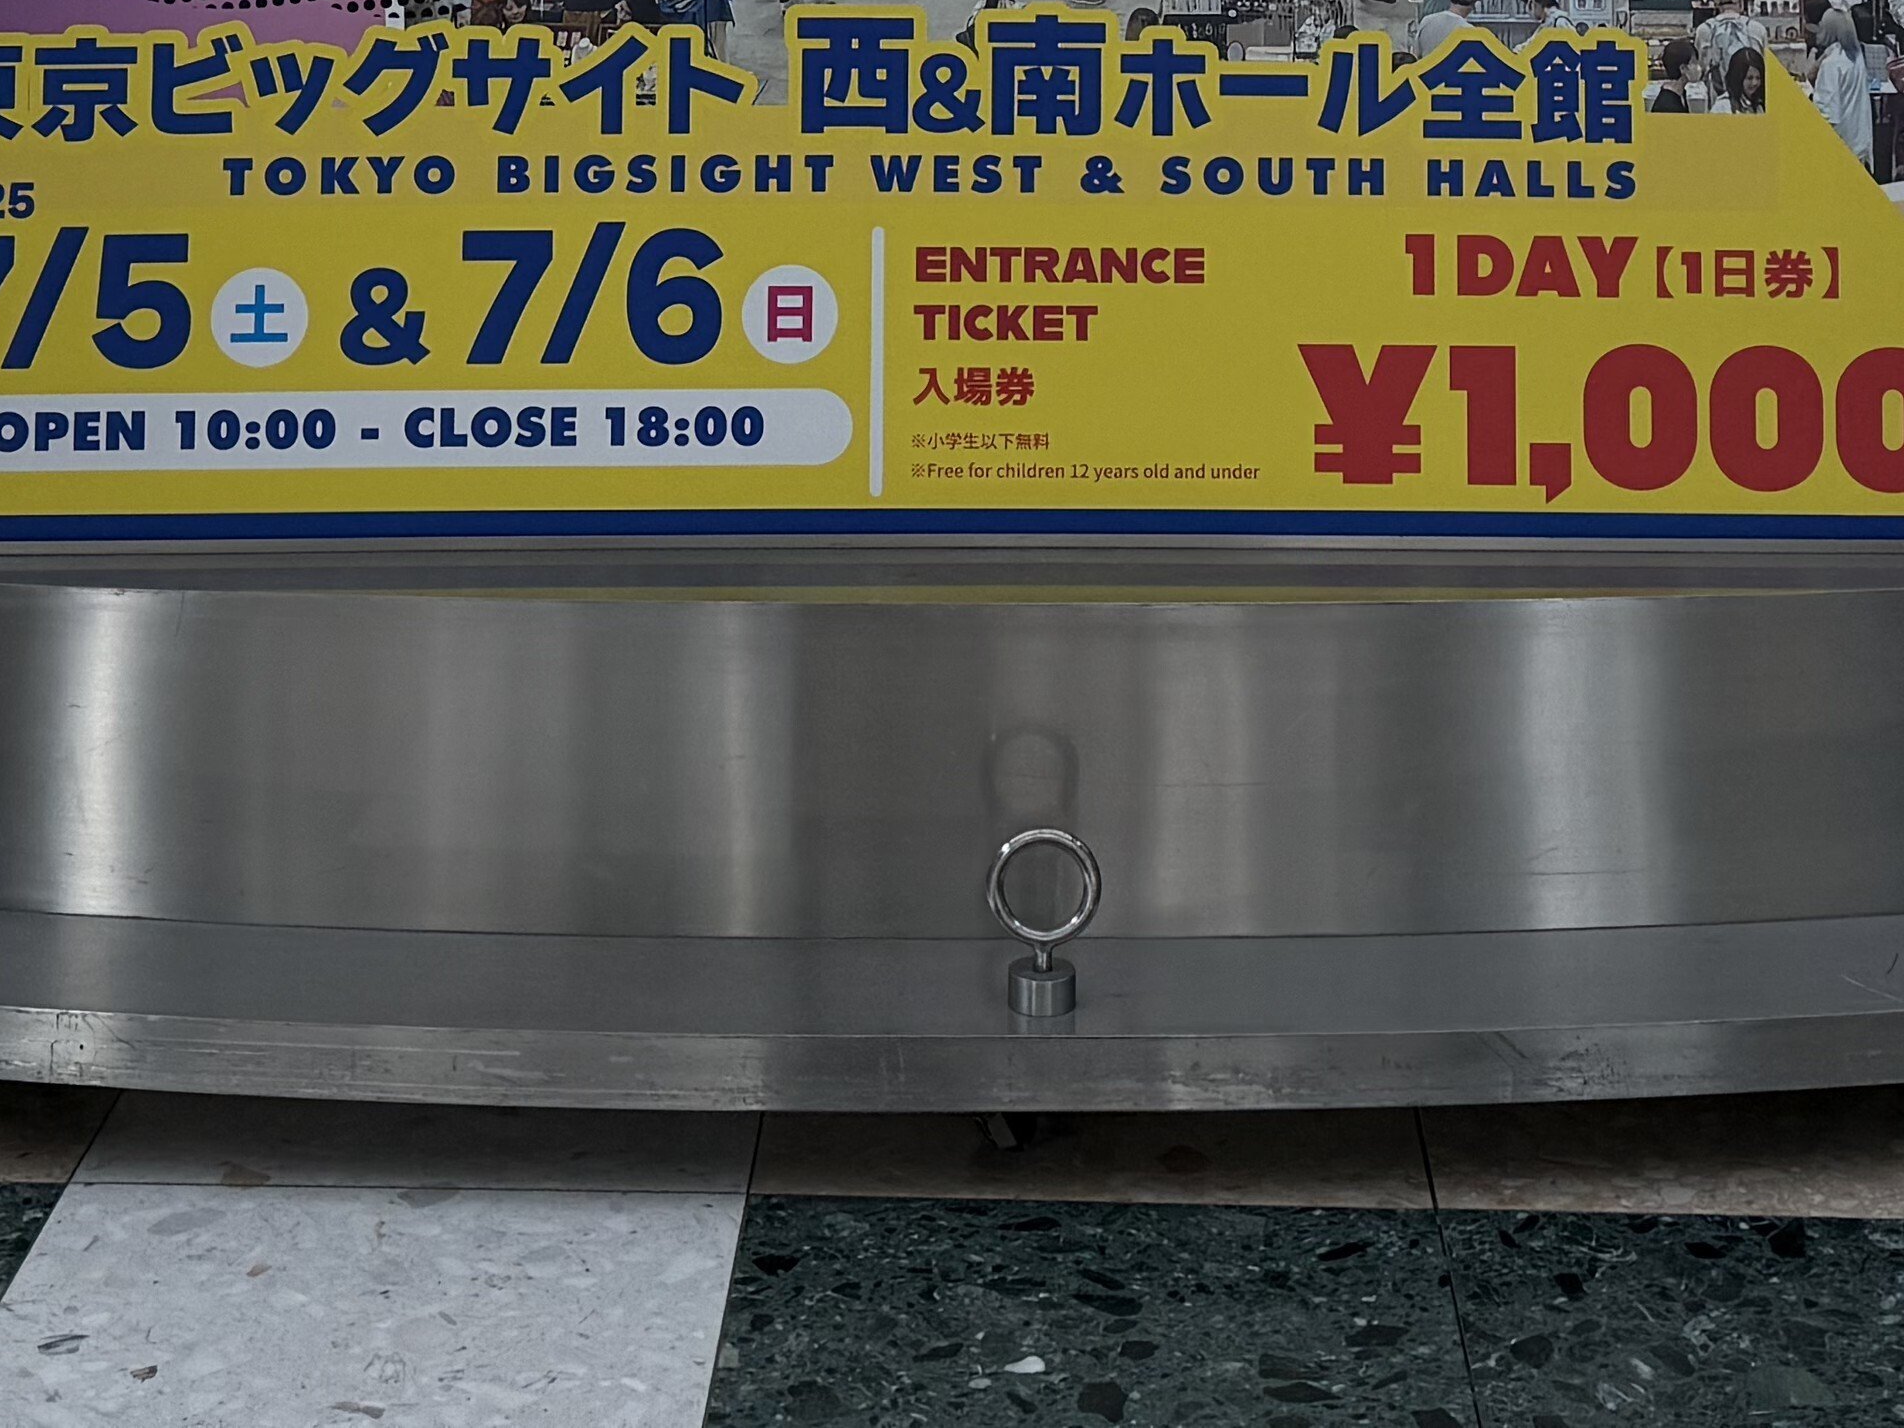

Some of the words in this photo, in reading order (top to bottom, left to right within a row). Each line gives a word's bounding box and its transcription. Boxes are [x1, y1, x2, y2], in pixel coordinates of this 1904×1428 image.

[800, 15, 1637, 146] 西&南ホール全館
[223, 156, 458, 197] TOKYO
[498, 154, 835, 194] BIGSIGHT
[872, 155, 1044, 196] WEST
[1079, 155, 1125, 196] &
[1160, 156, 1386, 198] SOUTH
[1427, 158, 1637, 200] HALLS
[913, 247, 1205, 285] ENTRANCE
[1404, 233, 1638, 299] 1DAY
[1654, 245, 1844, 300] 【1日券】
[229, 283, 292, 344] 土
[340, 267, 431, 366] &
[461, 222, 724, 366] 7/6
[765, 284, 815, 344] 日
[913, 304, 1098, 342] TICKET
[913, 367, 1036, 407] 入場券
[174, 409, 337, 450] 10:00
[403, 407, 577, 449] CLOSE
[603, 406, 765, 447] 18:00
[911, 432, 1050, 451] ※小学生以下無料
[968, 462, 993, 479] for
[996, 462, 1065, 480] children
[1070, 463, 1089, 479] 12
[1093, 465, 1139, 482] years
[1143, 462, 1169, 480] old
[1173, 462, 1206, 480] and
[1210, 463, 1260, 481] under
